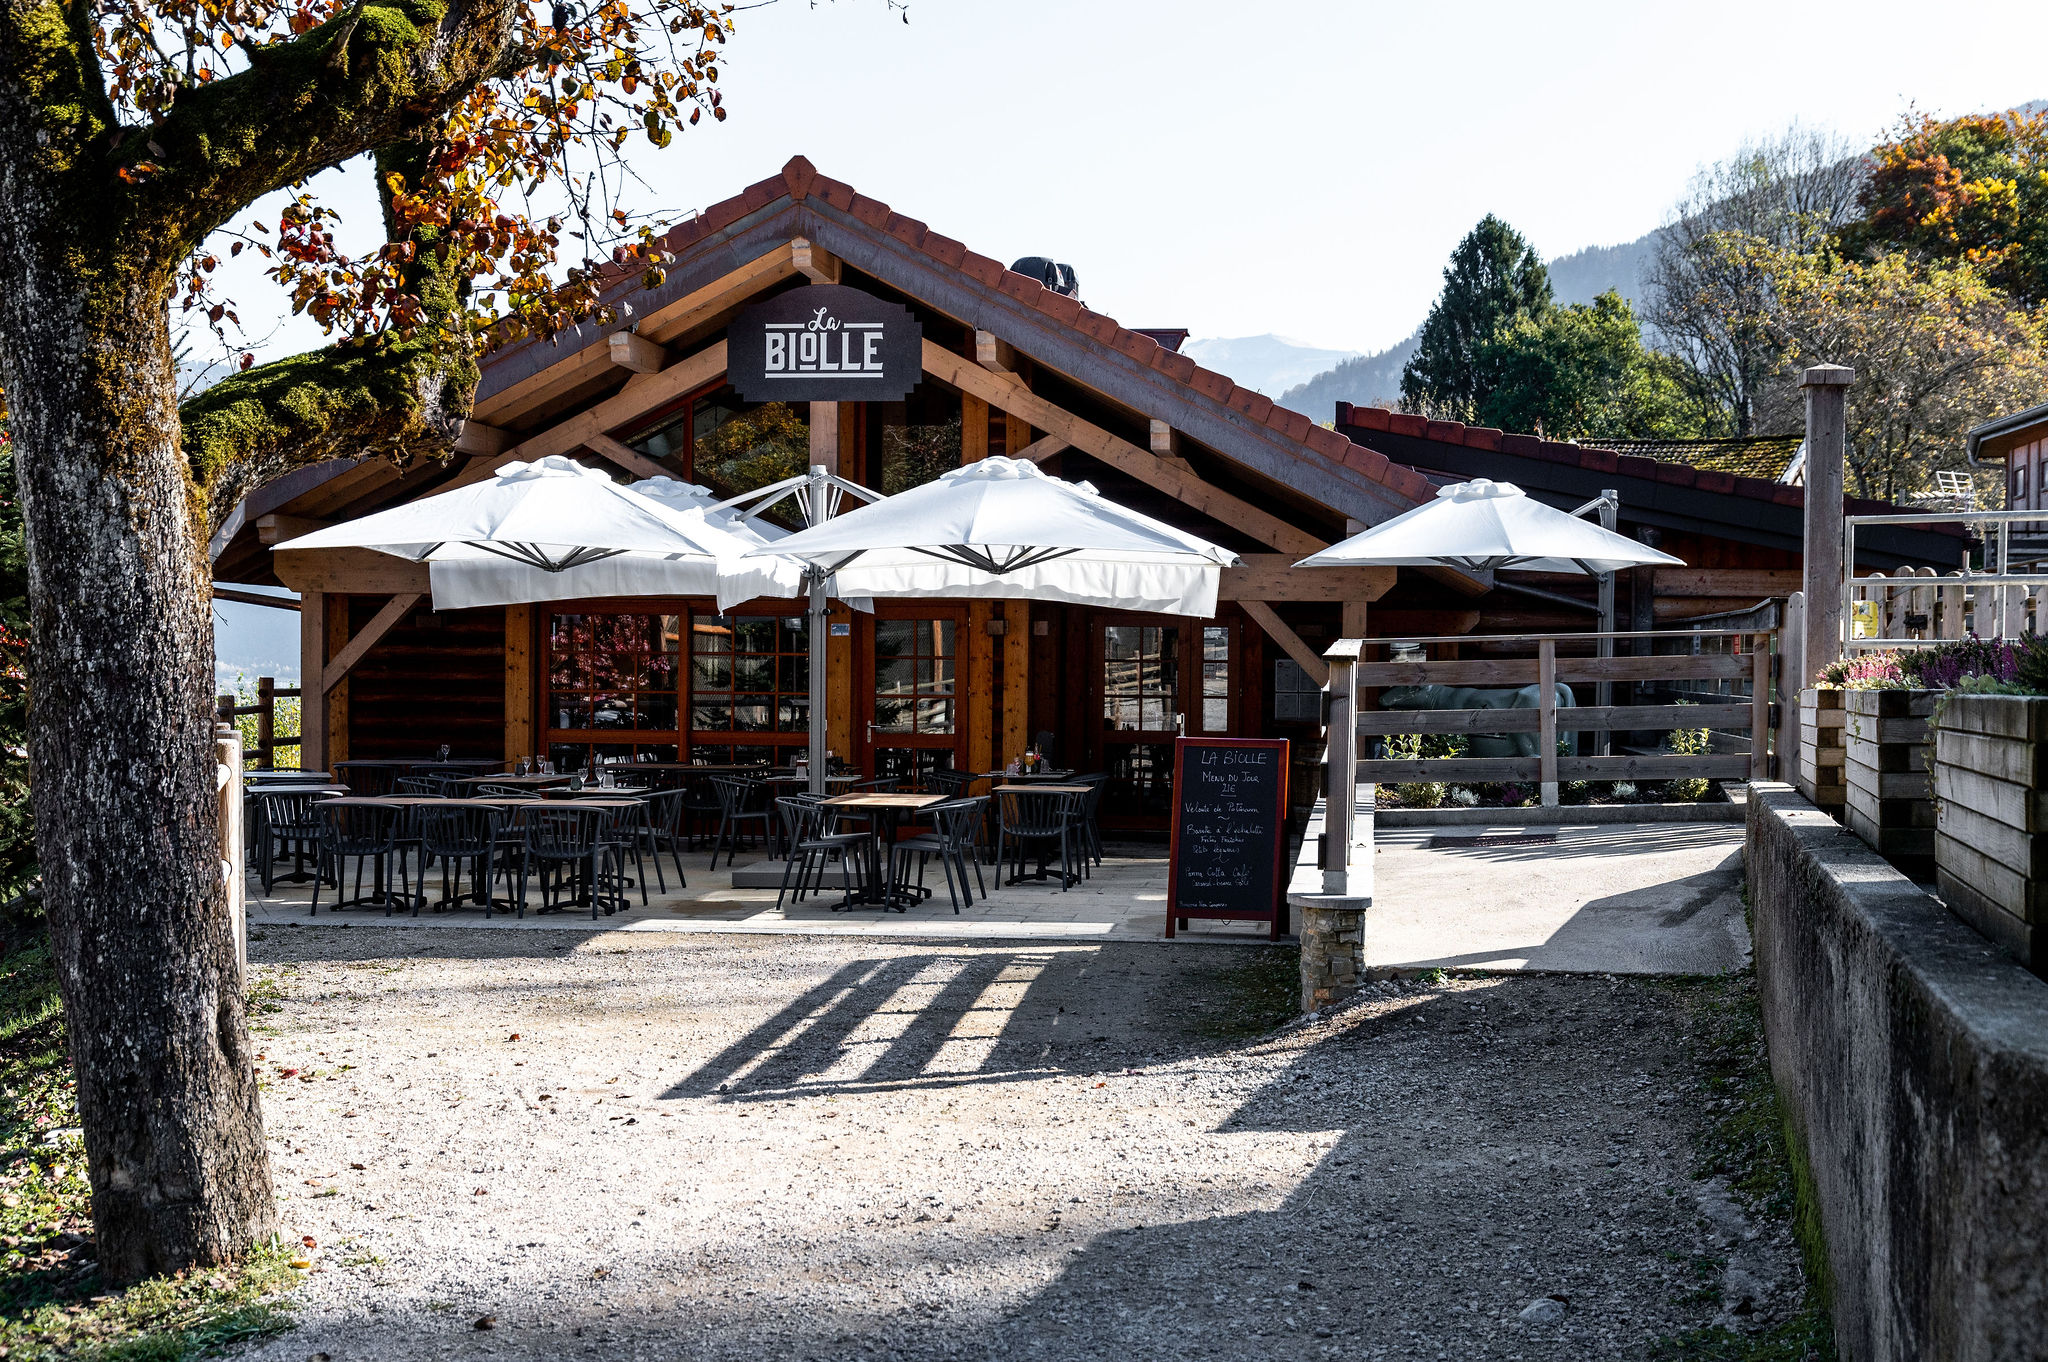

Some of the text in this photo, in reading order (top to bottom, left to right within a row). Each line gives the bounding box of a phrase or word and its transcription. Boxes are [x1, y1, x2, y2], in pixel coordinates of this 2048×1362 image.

[807, 306, 841, 332] La
[765, 331, 884, 371] BIOLLE
[1201, 750, 1218, 765] LA
